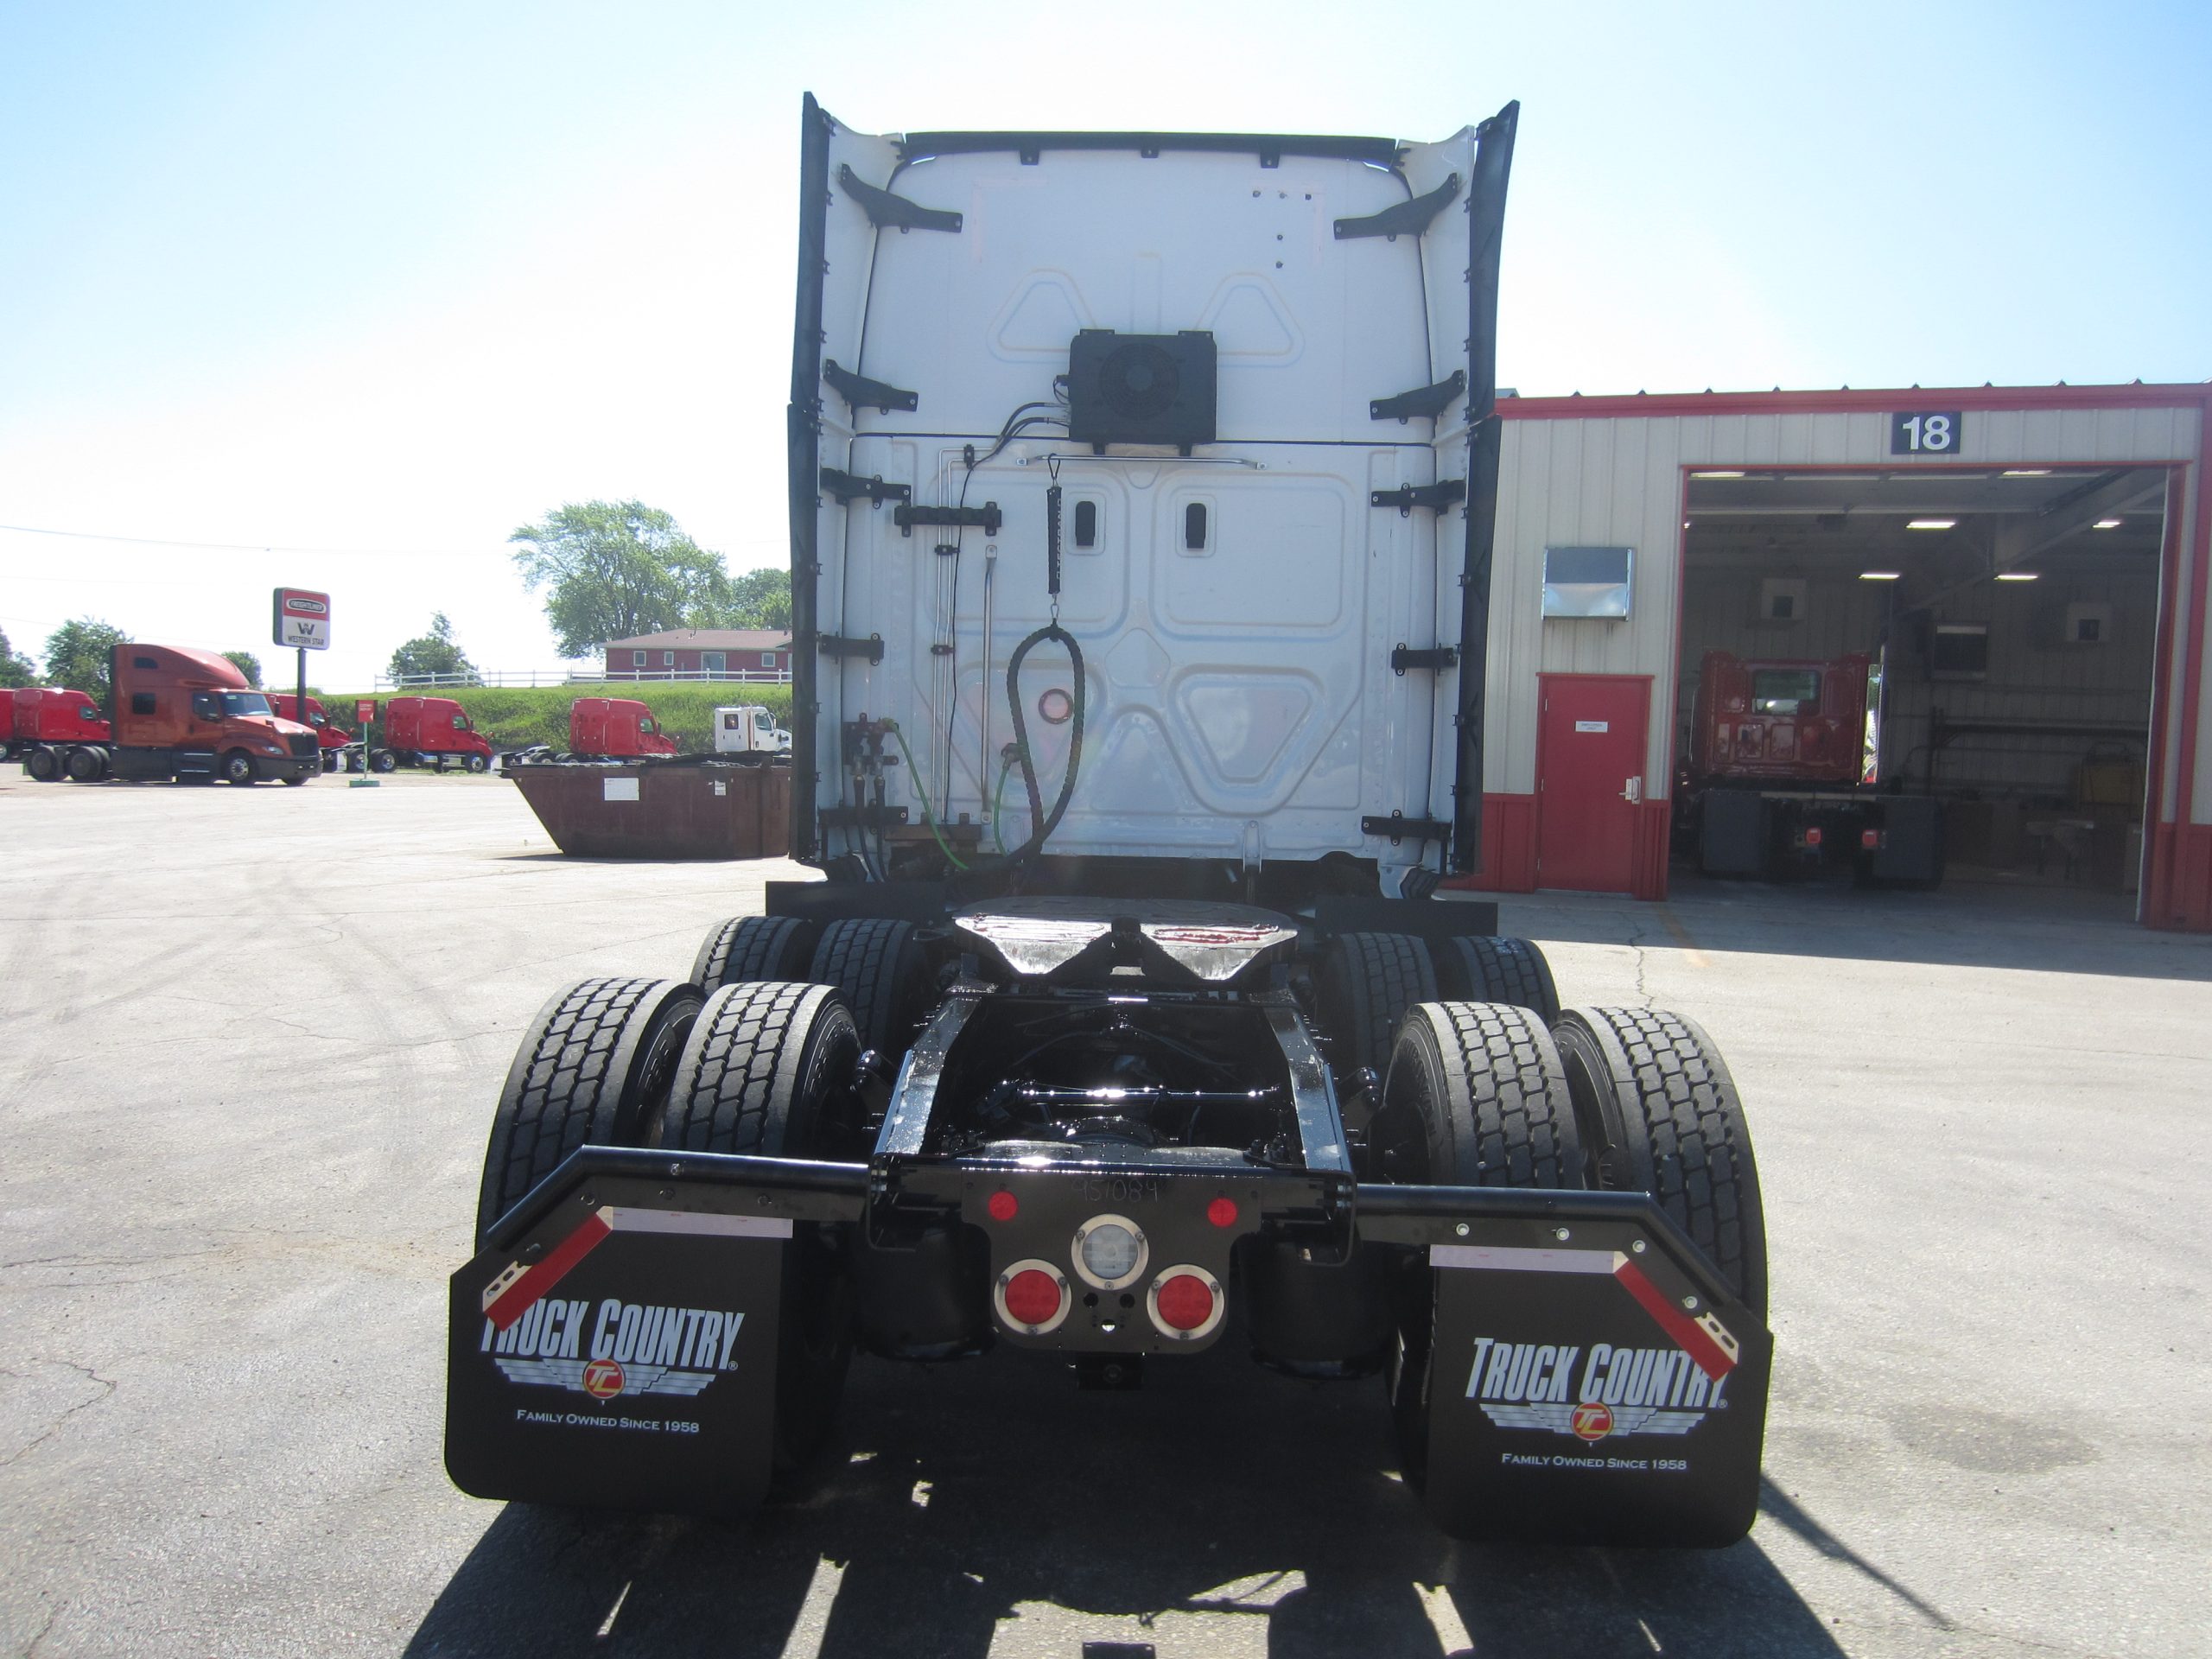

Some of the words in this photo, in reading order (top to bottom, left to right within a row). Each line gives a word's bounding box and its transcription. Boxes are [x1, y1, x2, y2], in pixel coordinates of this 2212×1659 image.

[1902, 415, 1950, 450] 18
[590, 1298, 746, 1370] COUNTRY
[1465, 1337, 1580, 1402] TRUCK
[517, 1409, 564, 1423] FAMILY
[566, 1413, 617, 1427] OWNED
[620, 1417, 660, 1431] SINCE
[664, 1421, 701, 1433] 1958
[1502, 1453, 1550, 1465] FAMILY
[1553, 1455, 1605, 1468] OWNED
[1606, 1458, 1648, 1469] SINCE
[1652, 1459, 1688, 1470] 1958
